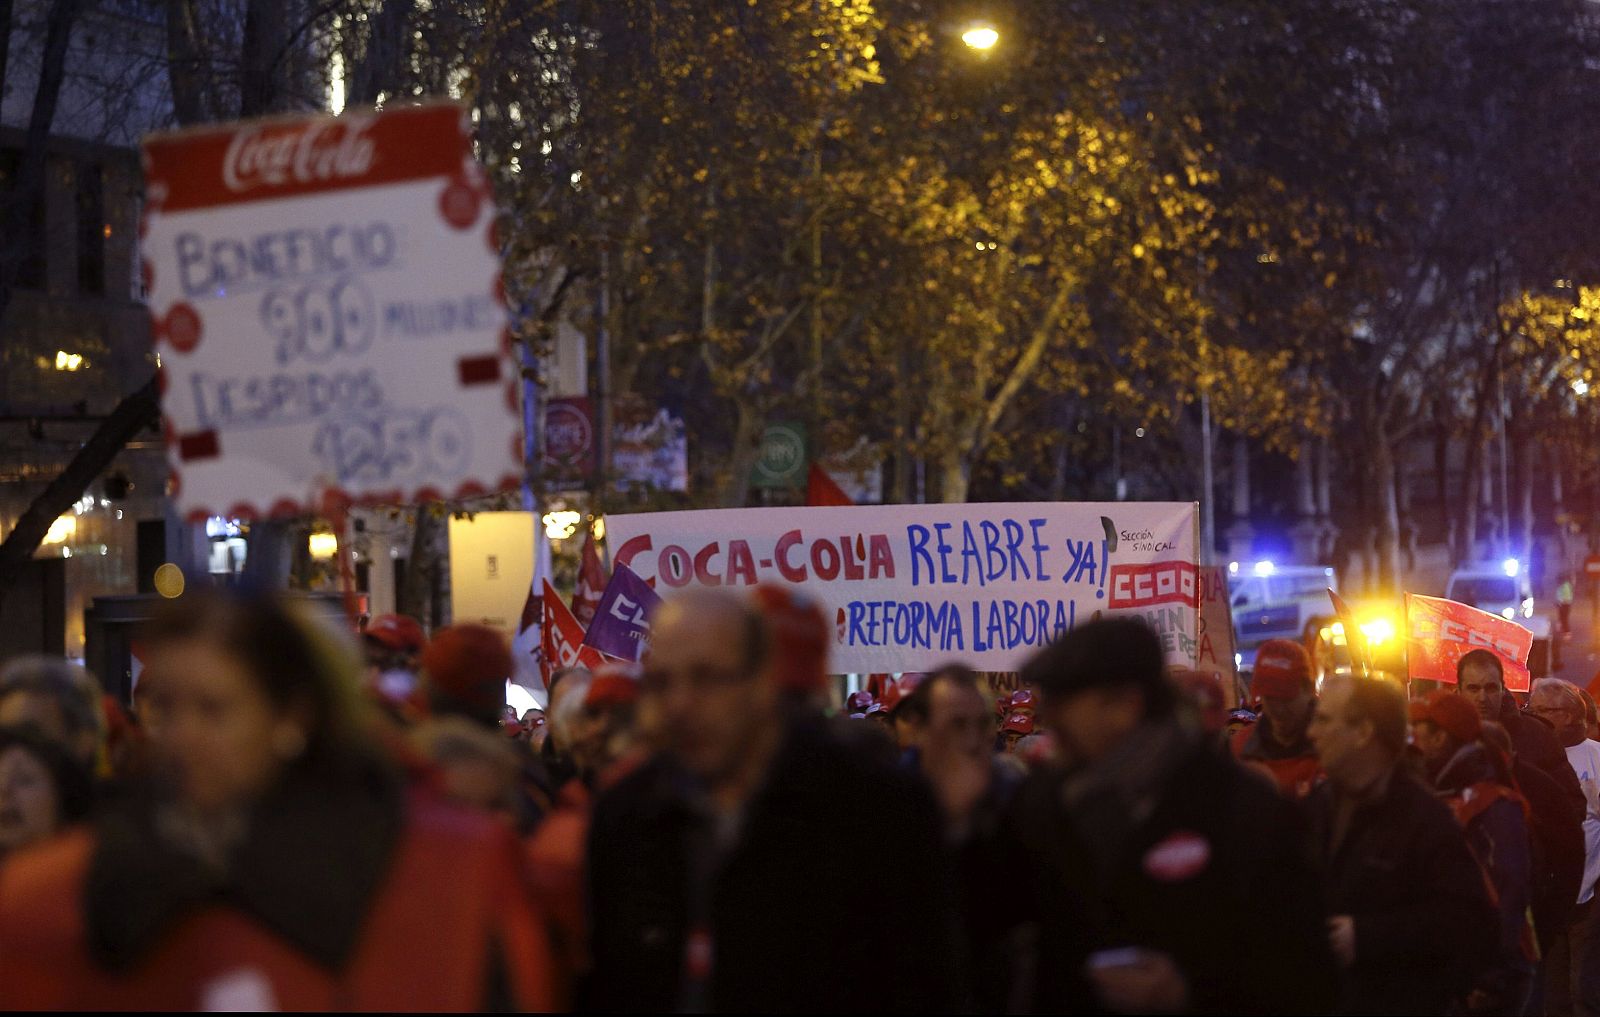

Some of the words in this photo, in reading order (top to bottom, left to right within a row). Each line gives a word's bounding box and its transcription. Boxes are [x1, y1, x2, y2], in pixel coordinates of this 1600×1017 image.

[260, 274, 377, 364] 900
[190, 370, 384, 430] DESPIDOS
[614, 529, 895, 587] COCA-COLA
[907, 518, 1050, 586] REABRE
[1062, 538, 1108, 599] YA!
[1120, 529, 1155, 542] SECCIÓN
[1132, 541, 1176, 552] SINDICAL
[1114, 570, 1195, 601] CCOO
[848, 600, 964, 650] REFORMA
